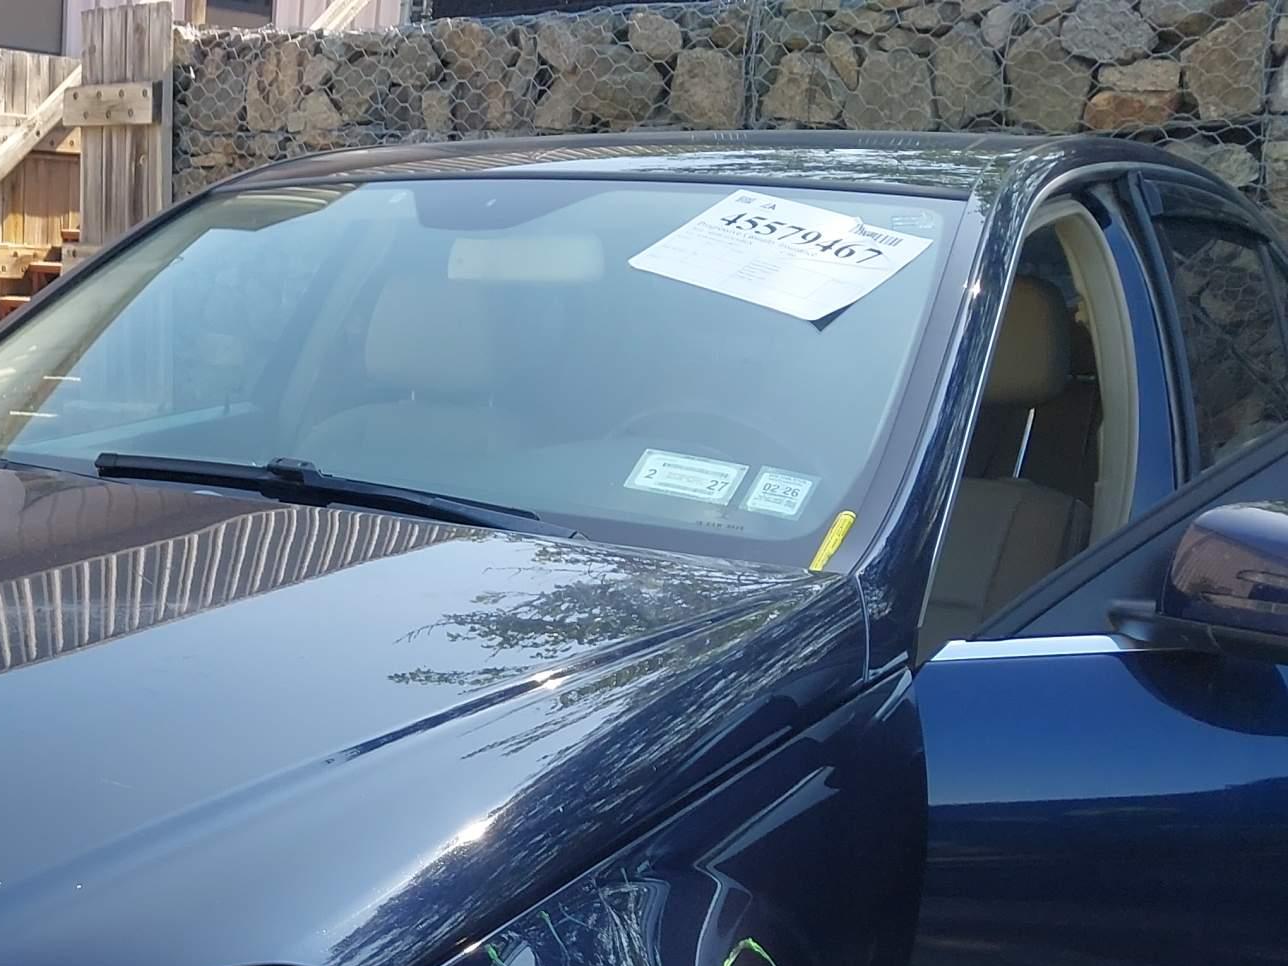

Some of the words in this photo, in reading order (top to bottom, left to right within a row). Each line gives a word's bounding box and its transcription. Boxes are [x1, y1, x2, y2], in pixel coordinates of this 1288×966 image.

[720, 212, 882, 264] 45579467
[644, 468, 658, 480] 2
[706, 479, 730, 493] 27
